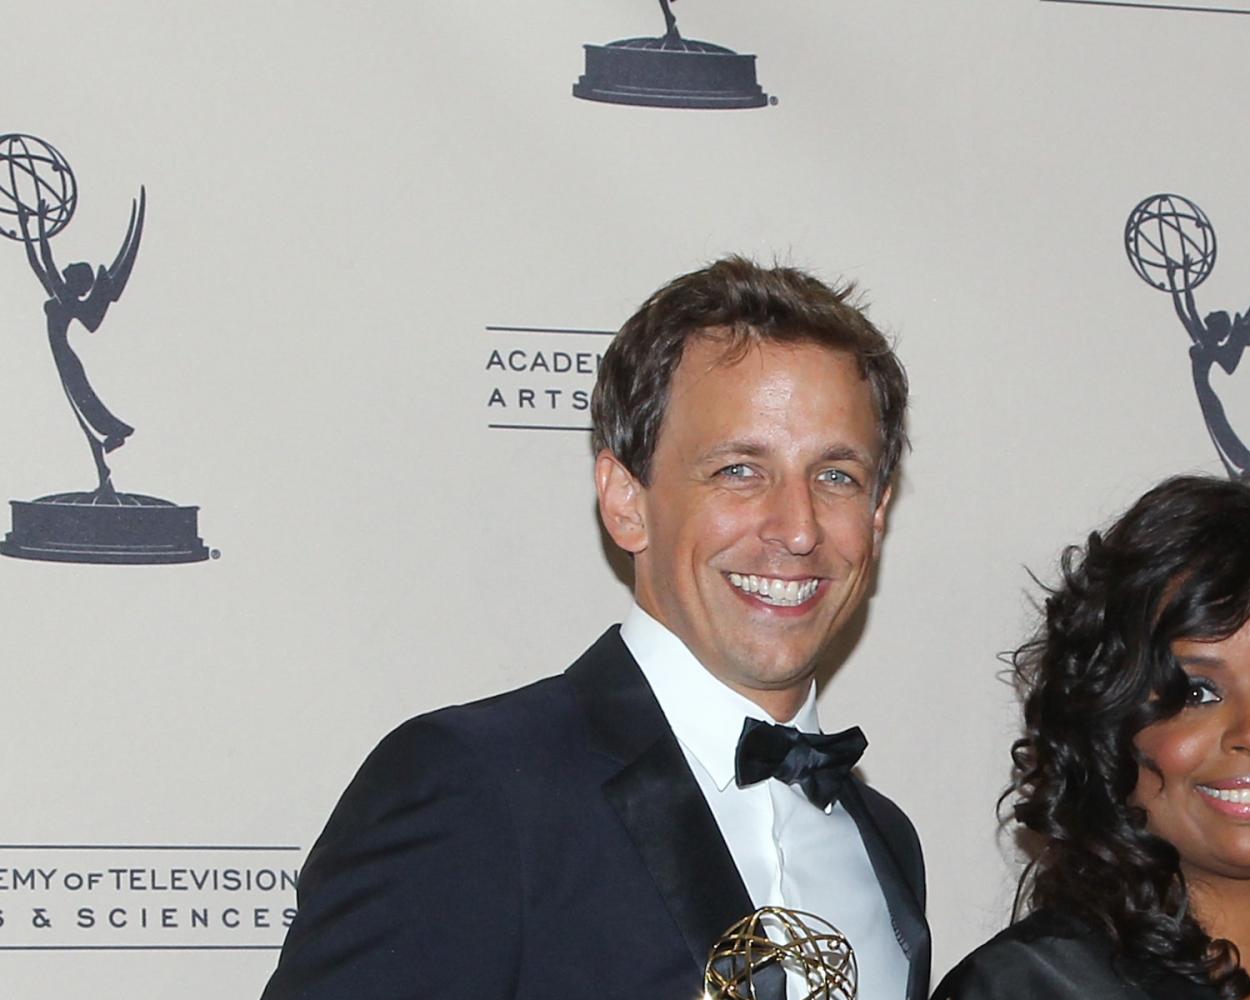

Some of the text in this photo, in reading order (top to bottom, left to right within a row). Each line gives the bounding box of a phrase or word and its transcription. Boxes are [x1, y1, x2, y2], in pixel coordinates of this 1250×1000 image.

[485, 349, 605, 374] ACADE
[487, 388, 590, 410] ARTS
[63, 873, 103, 891] OF
[108, 868, 299, 891] TELEVISION
[32, 908, 298, 928] & SCIENCES
